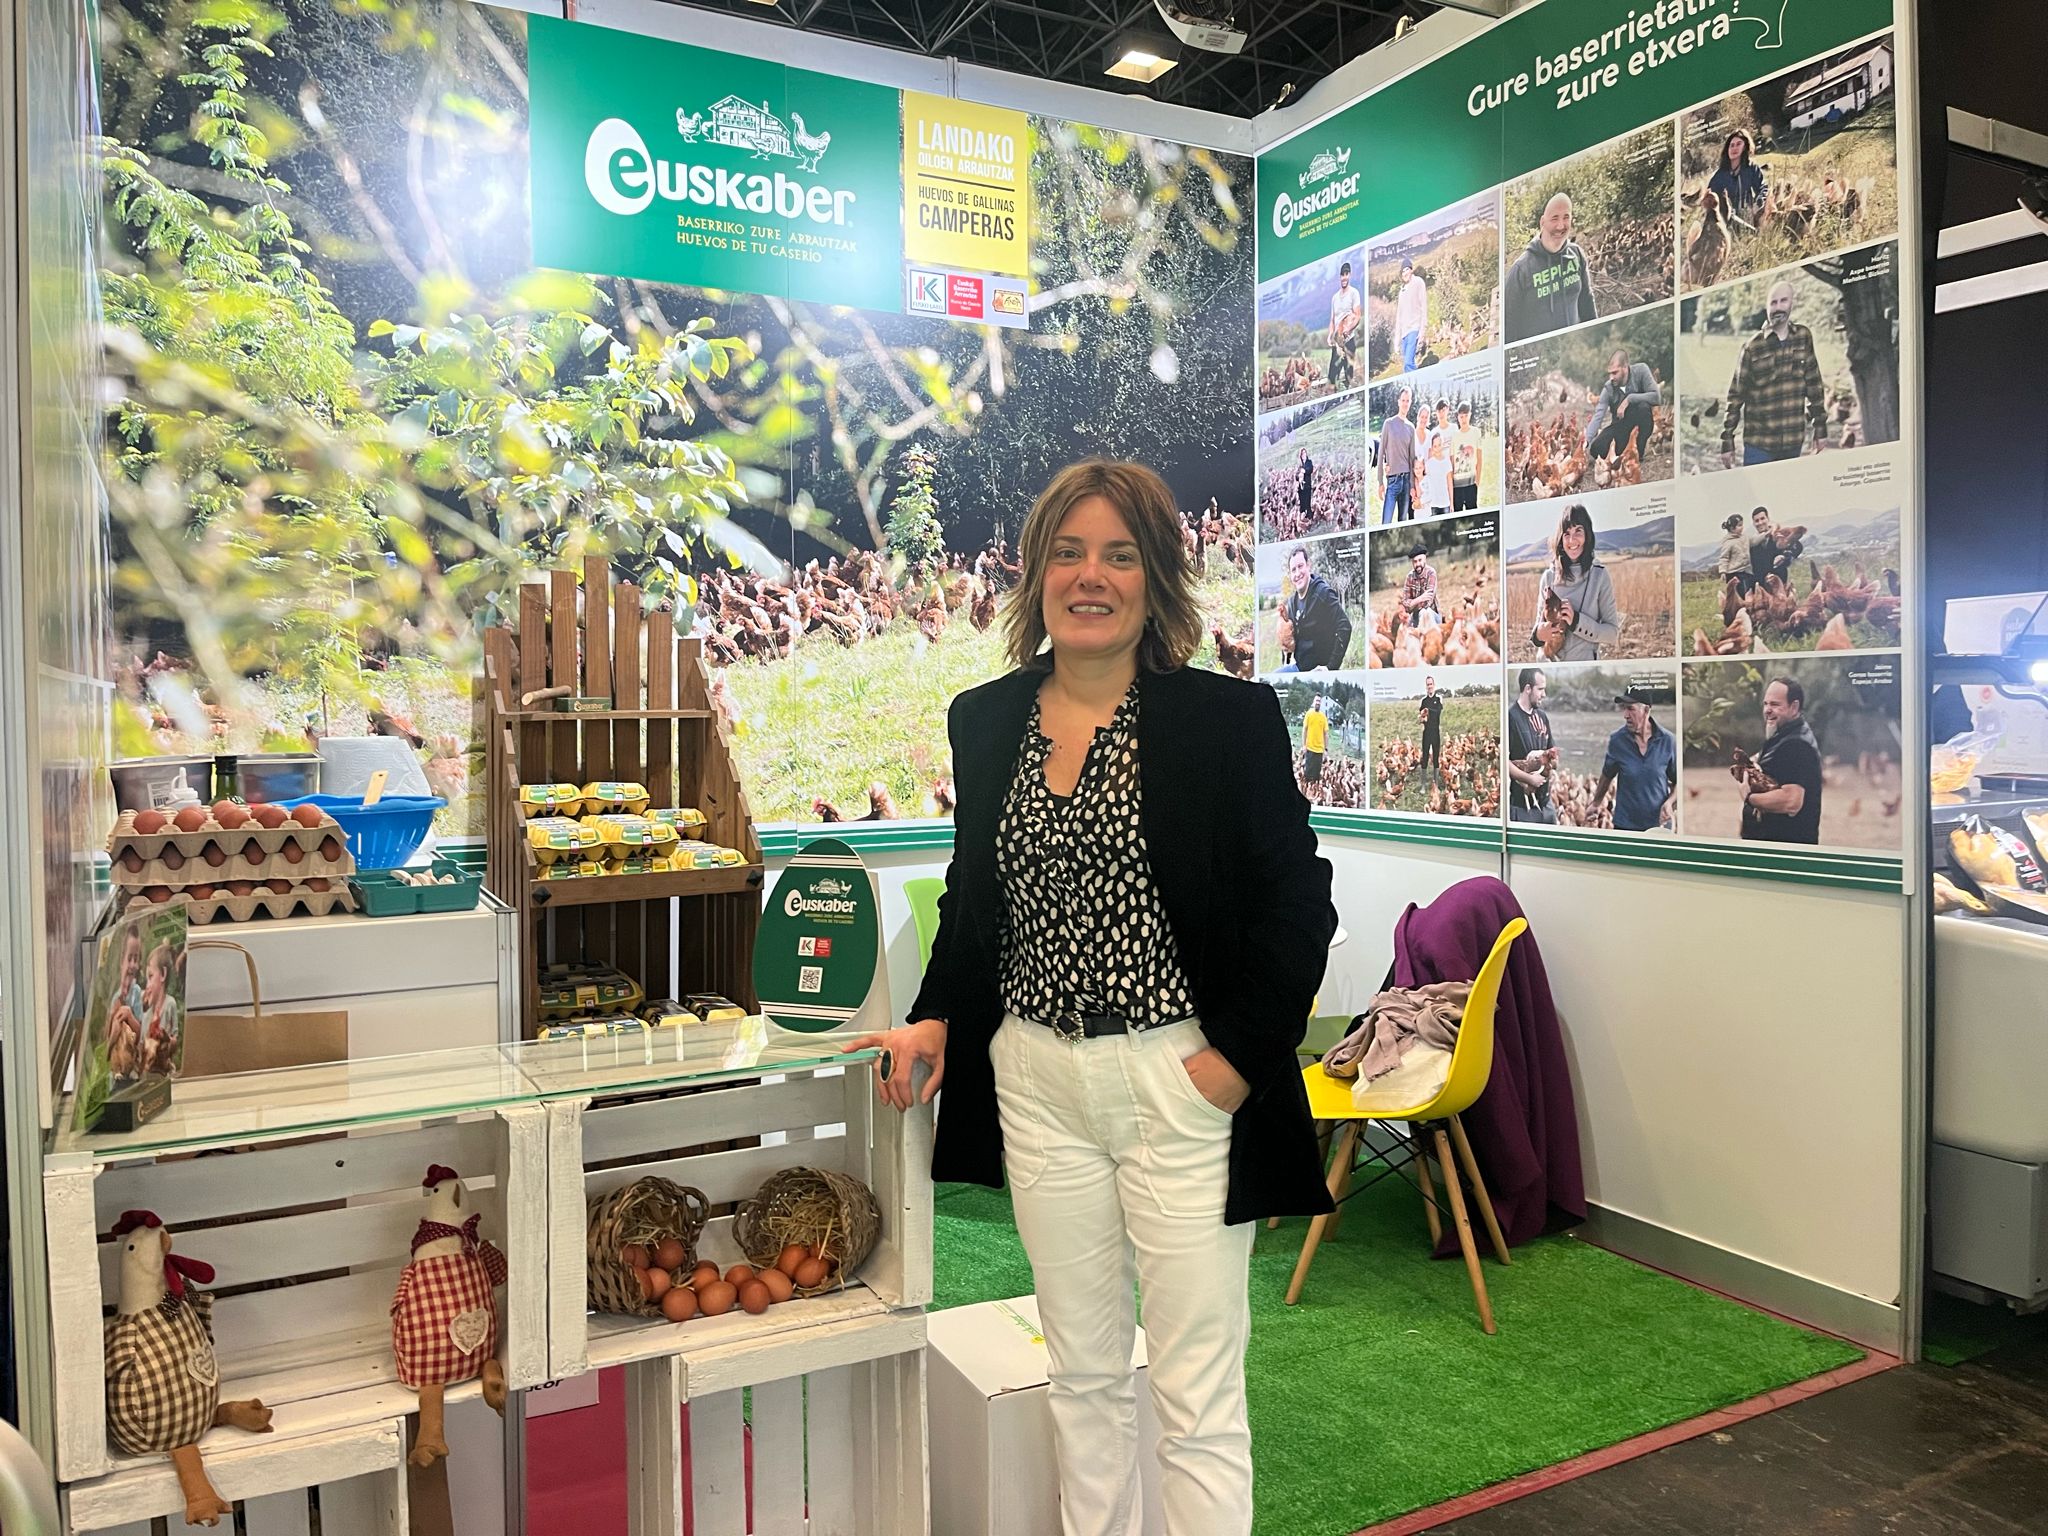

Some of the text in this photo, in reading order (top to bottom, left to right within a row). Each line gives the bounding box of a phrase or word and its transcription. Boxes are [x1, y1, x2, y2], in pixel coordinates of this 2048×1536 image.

[1467, 0, 1716, 116] Gure baserrietat
[1556, 13, 1730, 110] zure etxera
[918, 119, 1014, 164] LANDAKO
[918, 152, 1014, 182] OILOEN ARRAUTZAK
[918, 185, 1015, 213] HUEVOS DE GALLINAS
[677, 215, 857, 252] BASERRIKO ZURE ARRAUTZAK
[919, 203, 1014, 241] CAMPERAS
[677, 232, 822, 262] HUEVOS DE TU CASERÍO
